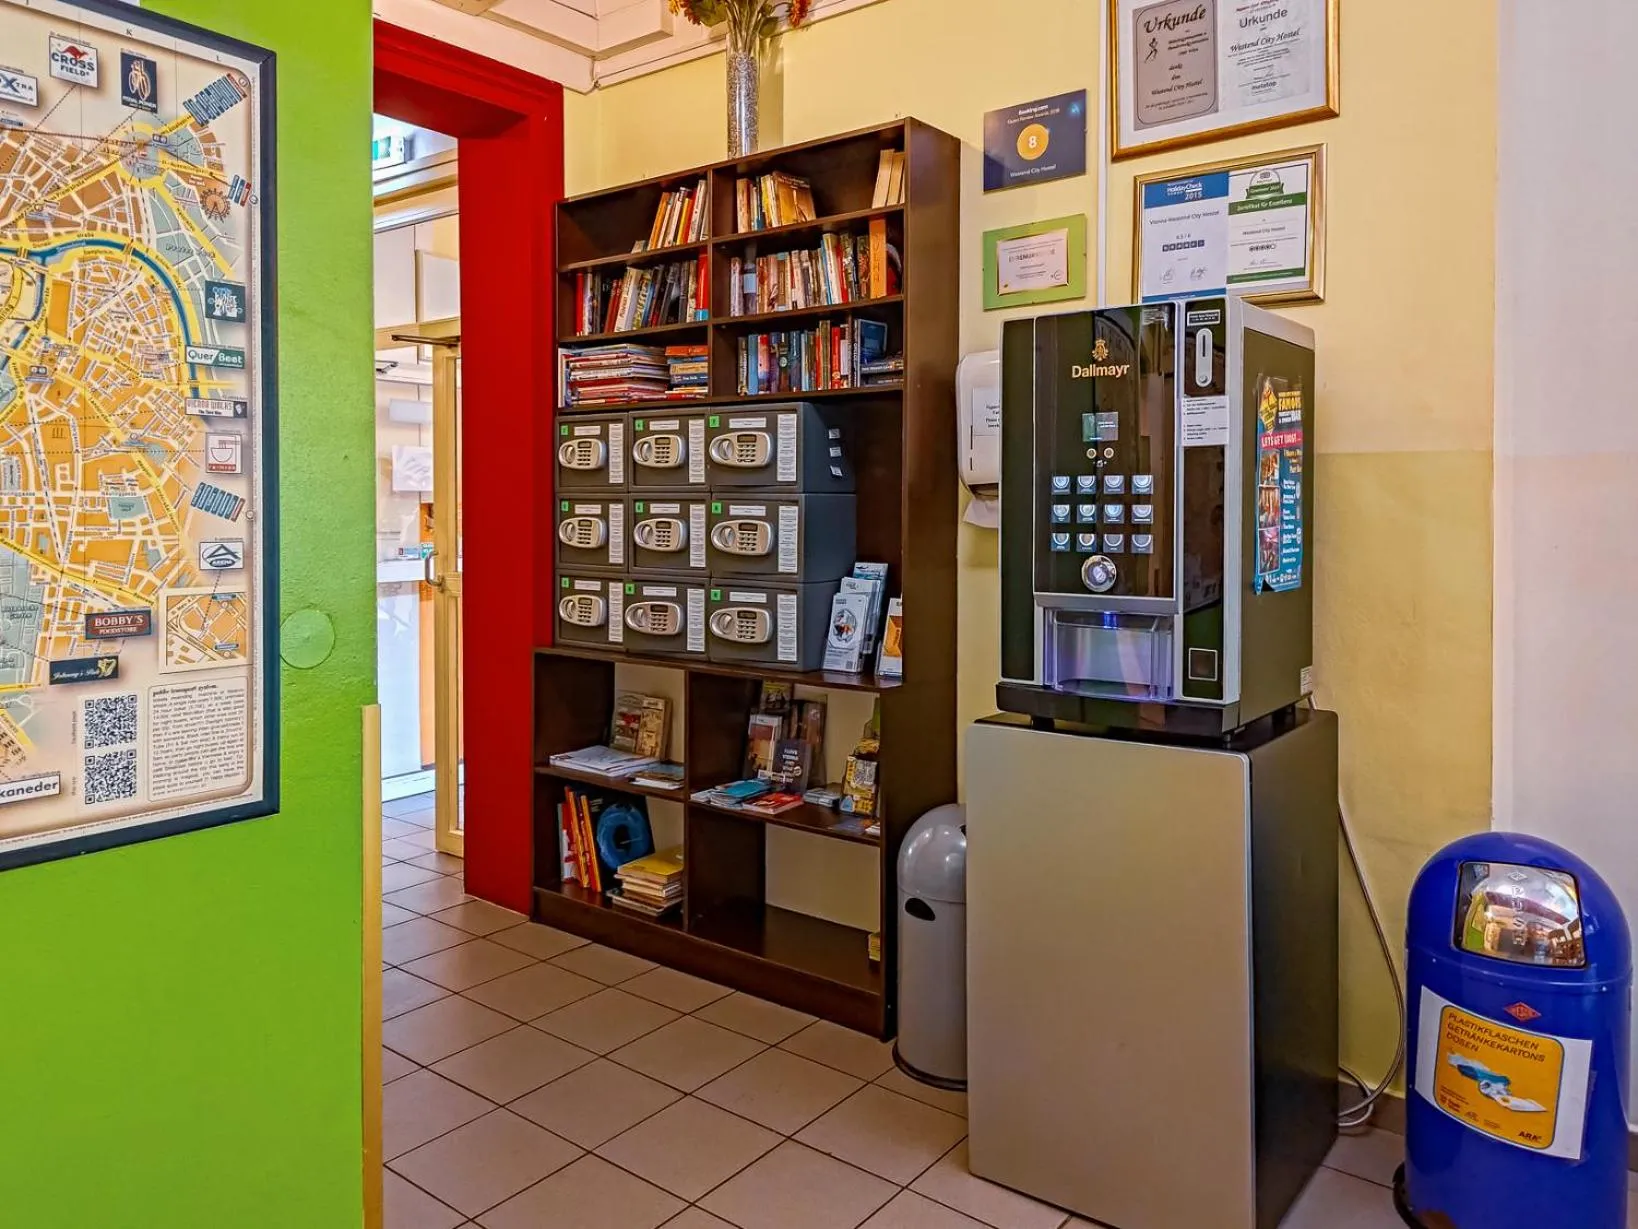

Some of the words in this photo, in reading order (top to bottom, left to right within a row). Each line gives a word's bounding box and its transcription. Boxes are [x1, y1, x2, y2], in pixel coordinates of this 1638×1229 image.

[1143, 4, 1206, 33] Urkunde
[1239, 8, 1288, 29] Urkunde
[1260, 35, 1275, 47] City
[1276, 27, 1302, 43] Hostel
[51, 52, 96, 72] CROSS
[1028, 135, 1037, 149] 8
[187, 348, 214, 362] Quer
[1071, 363, 1131, 379] Dallmayr
[94, 614, 145, 628] BOBBY'S
[1449, 1013, 1540, 1050] PLASTIKFLASCHEN
[1447, 1034, 1480, 1053] DOSEN
[1448, 1023, 1546, 1062] GETRÄNKEKARTONS
